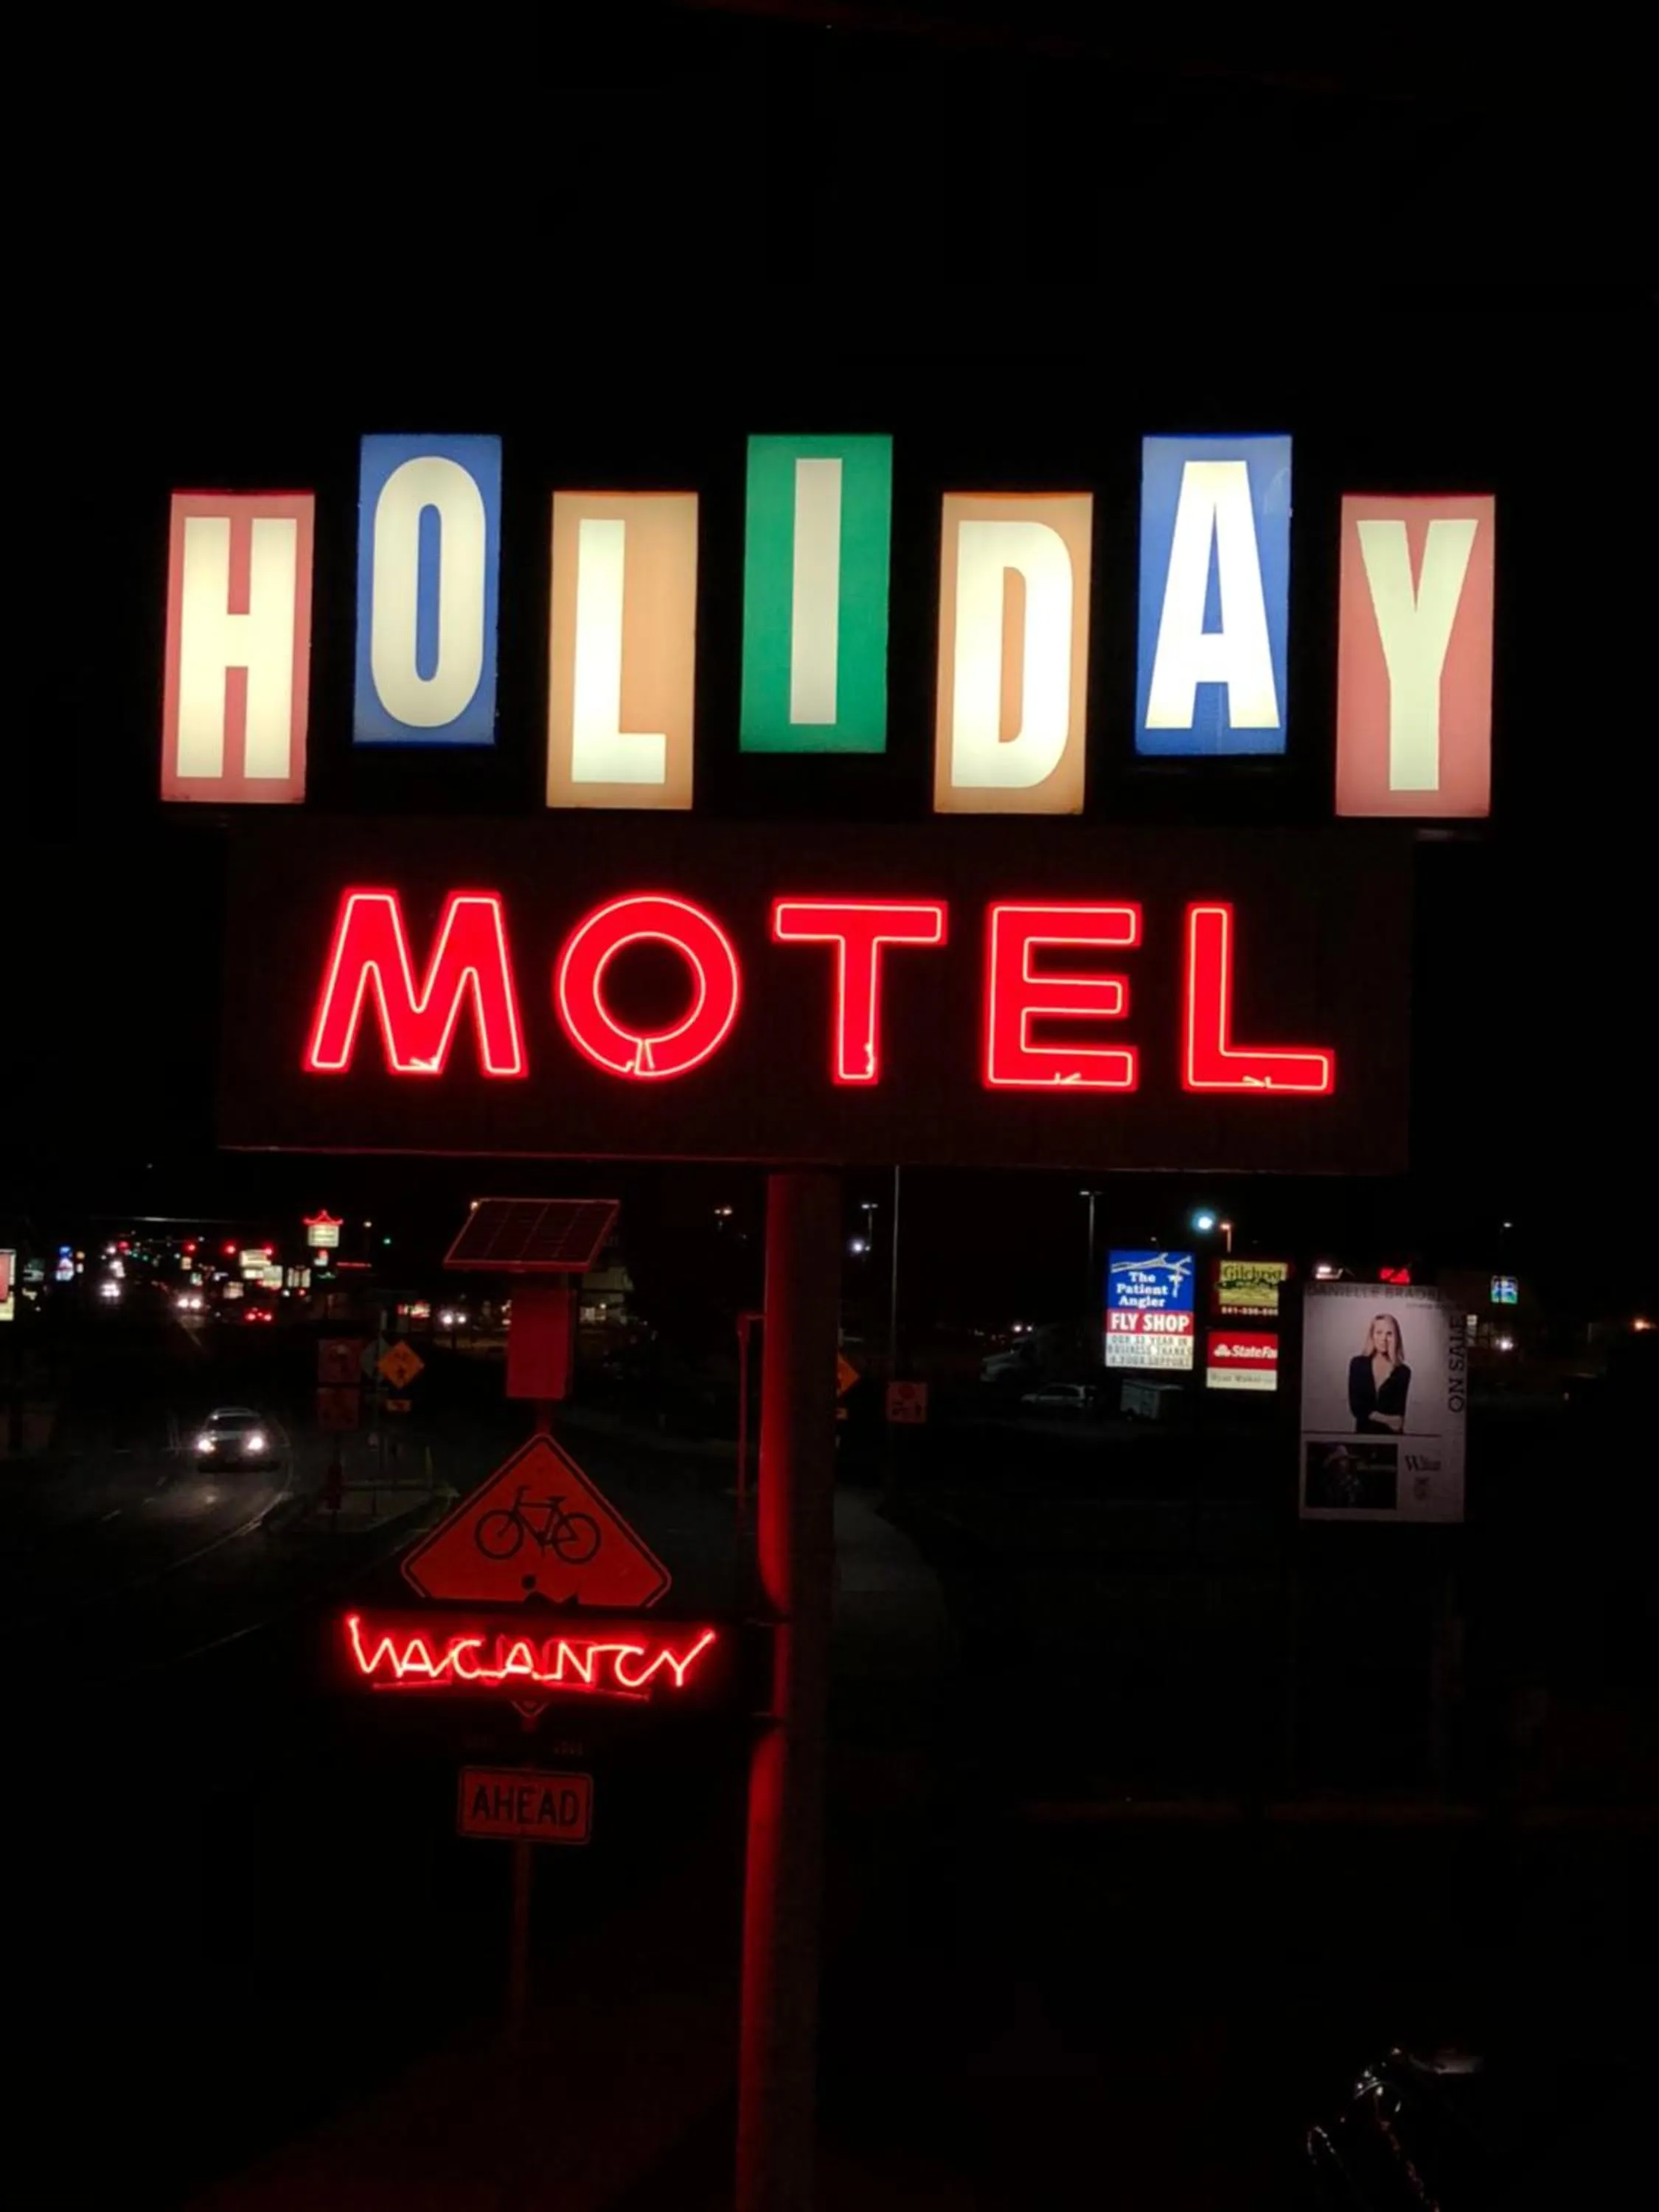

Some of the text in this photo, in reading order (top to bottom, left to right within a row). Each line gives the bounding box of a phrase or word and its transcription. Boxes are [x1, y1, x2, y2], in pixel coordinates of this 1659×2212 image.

[175, 456, 1479, 791] HOLIDAY
[304, 887, 1336, 1093] MOTEL
[1116, 1283, 1169, 1295] Patient
[1128, 1271, 1157, 1283] The
[1111, 1312, 1190, 1333] FLY SHOP
[1118, 1295, 1166, 1310] Angler
[1448, 1315, 1467, 1413] ON SALE
[346, 1613, 718, 1688] VACANCY
[470, 1784, 580, 1828] AHEAD
